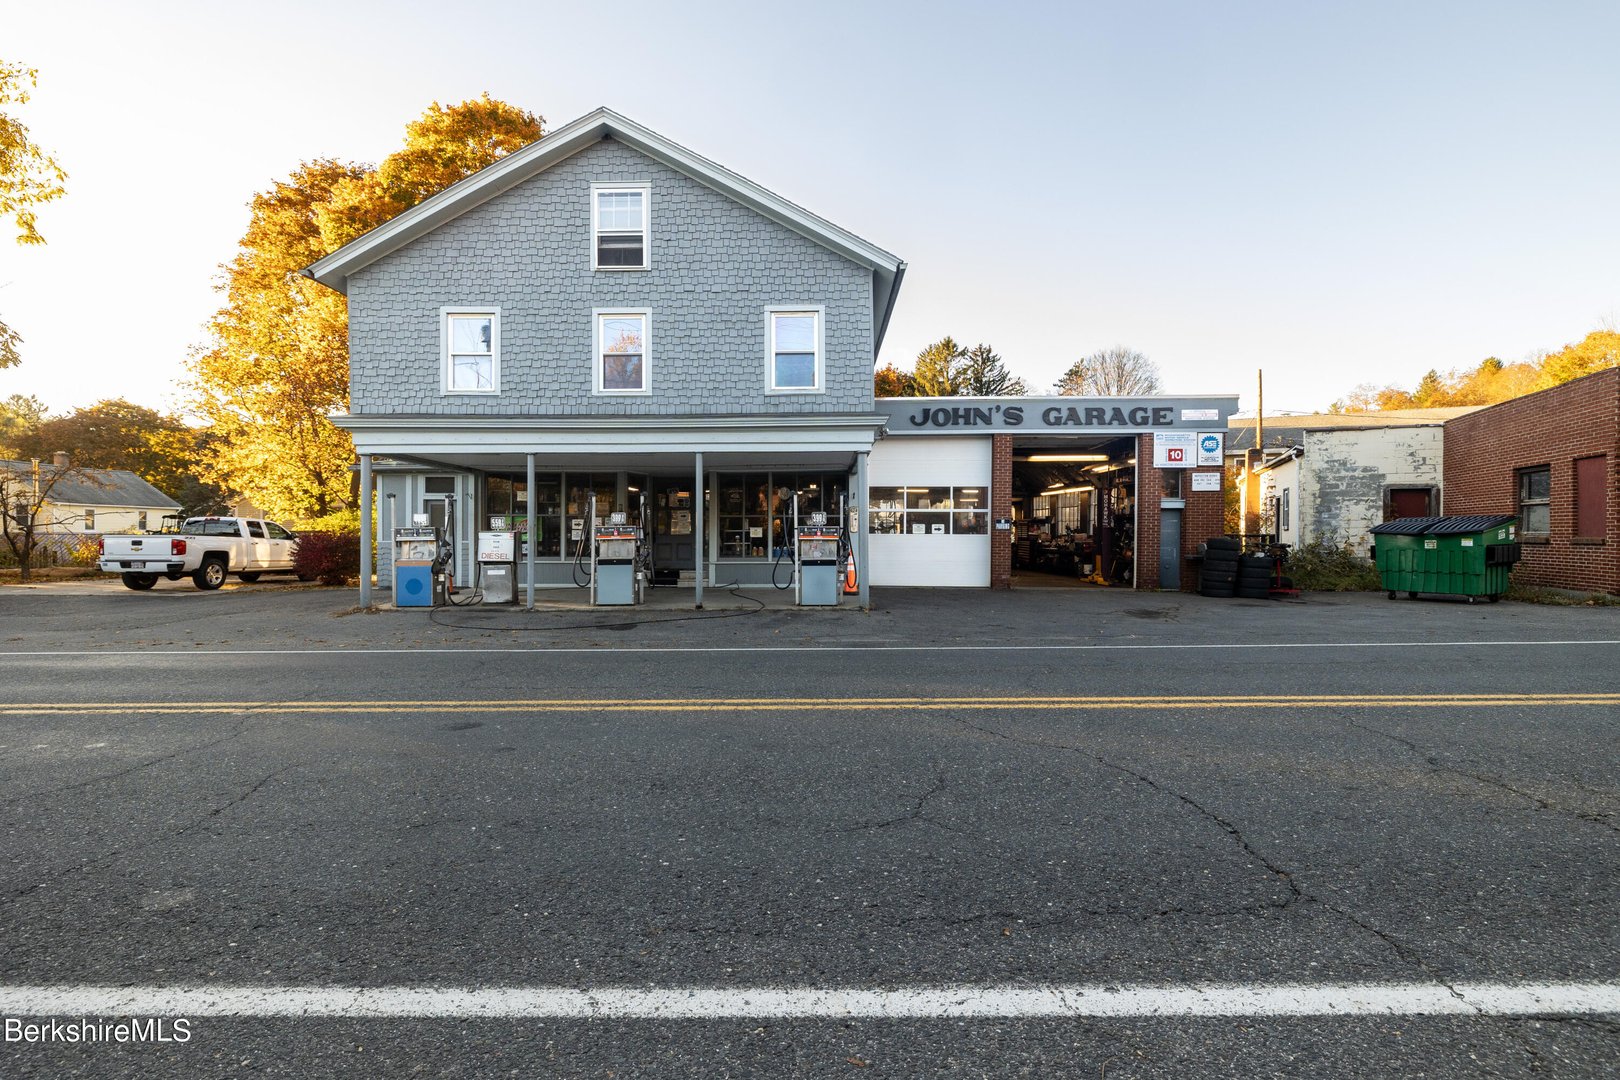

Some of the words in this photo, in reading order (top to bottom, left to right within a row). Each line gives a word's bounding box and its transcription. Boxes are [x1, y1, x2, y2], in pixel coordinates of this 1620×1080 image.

[909, 405, 1024, 426] JOHN'S
[1042, 406, 1174, 426] GARAGE
[1203, 440, 1217, 448] ASE
[1169, 450, 1182, 460] 10
[481, 552, 510, 560] DIESEL
